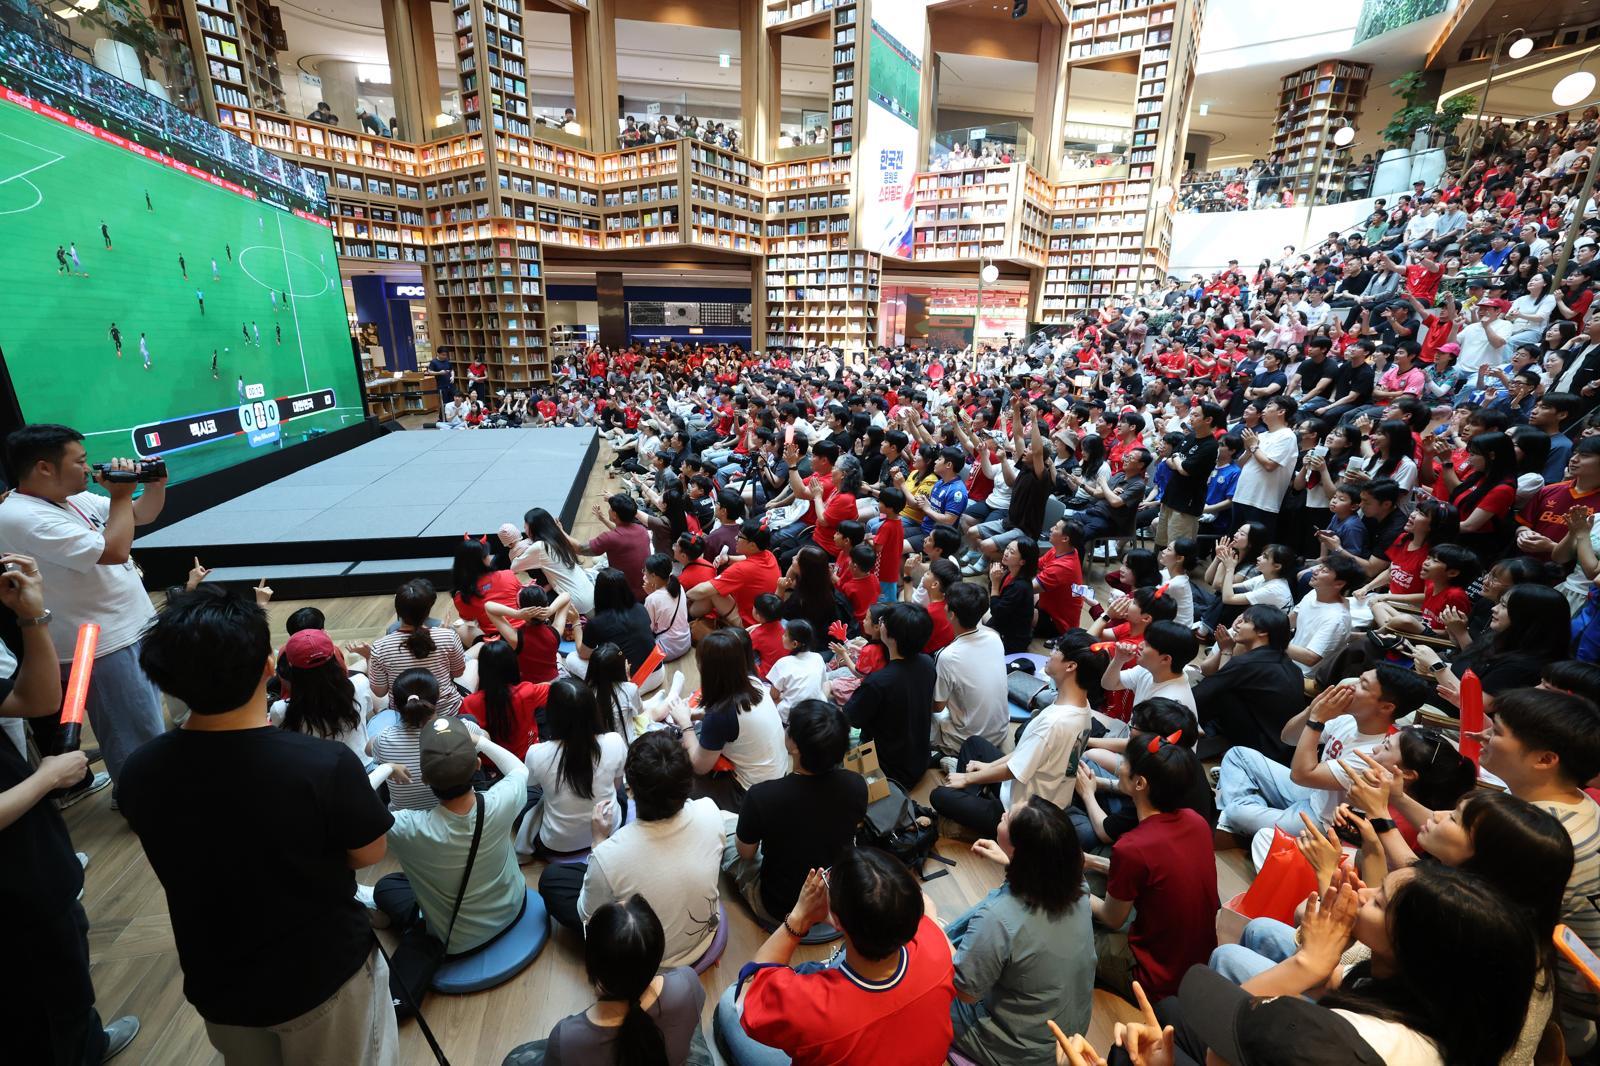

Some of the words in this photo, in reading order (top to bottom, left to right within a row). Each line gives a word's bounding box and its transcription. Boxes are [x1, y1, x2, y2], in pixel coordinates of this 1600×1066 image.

[880, 149, 904, 170] 한국전
[269, 404, 275, 420] 0
[292, 398, 314, 413] 대한민국
[244, 410, 251, 426] 0
[189, 419, 218, 437] 멕시코
